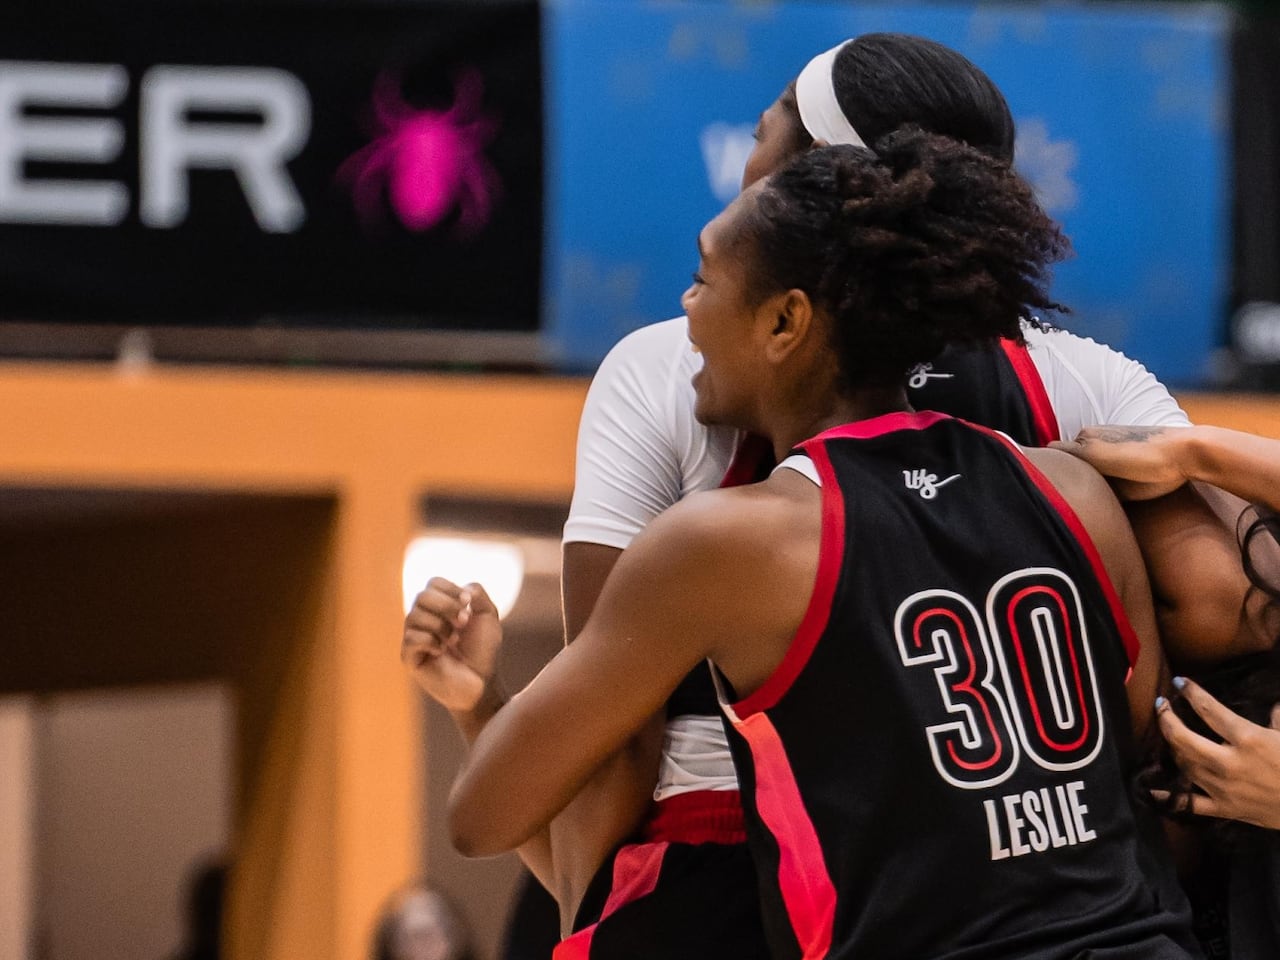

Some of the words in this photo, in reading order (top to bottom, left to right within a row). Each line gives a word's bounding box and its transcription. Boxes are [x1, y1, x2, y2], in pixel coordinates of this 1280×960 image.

[0, 60, 311, 234] ER
[895, 567, 1103, 789] 30
[984, 781, 1096, 860] LESLIE
